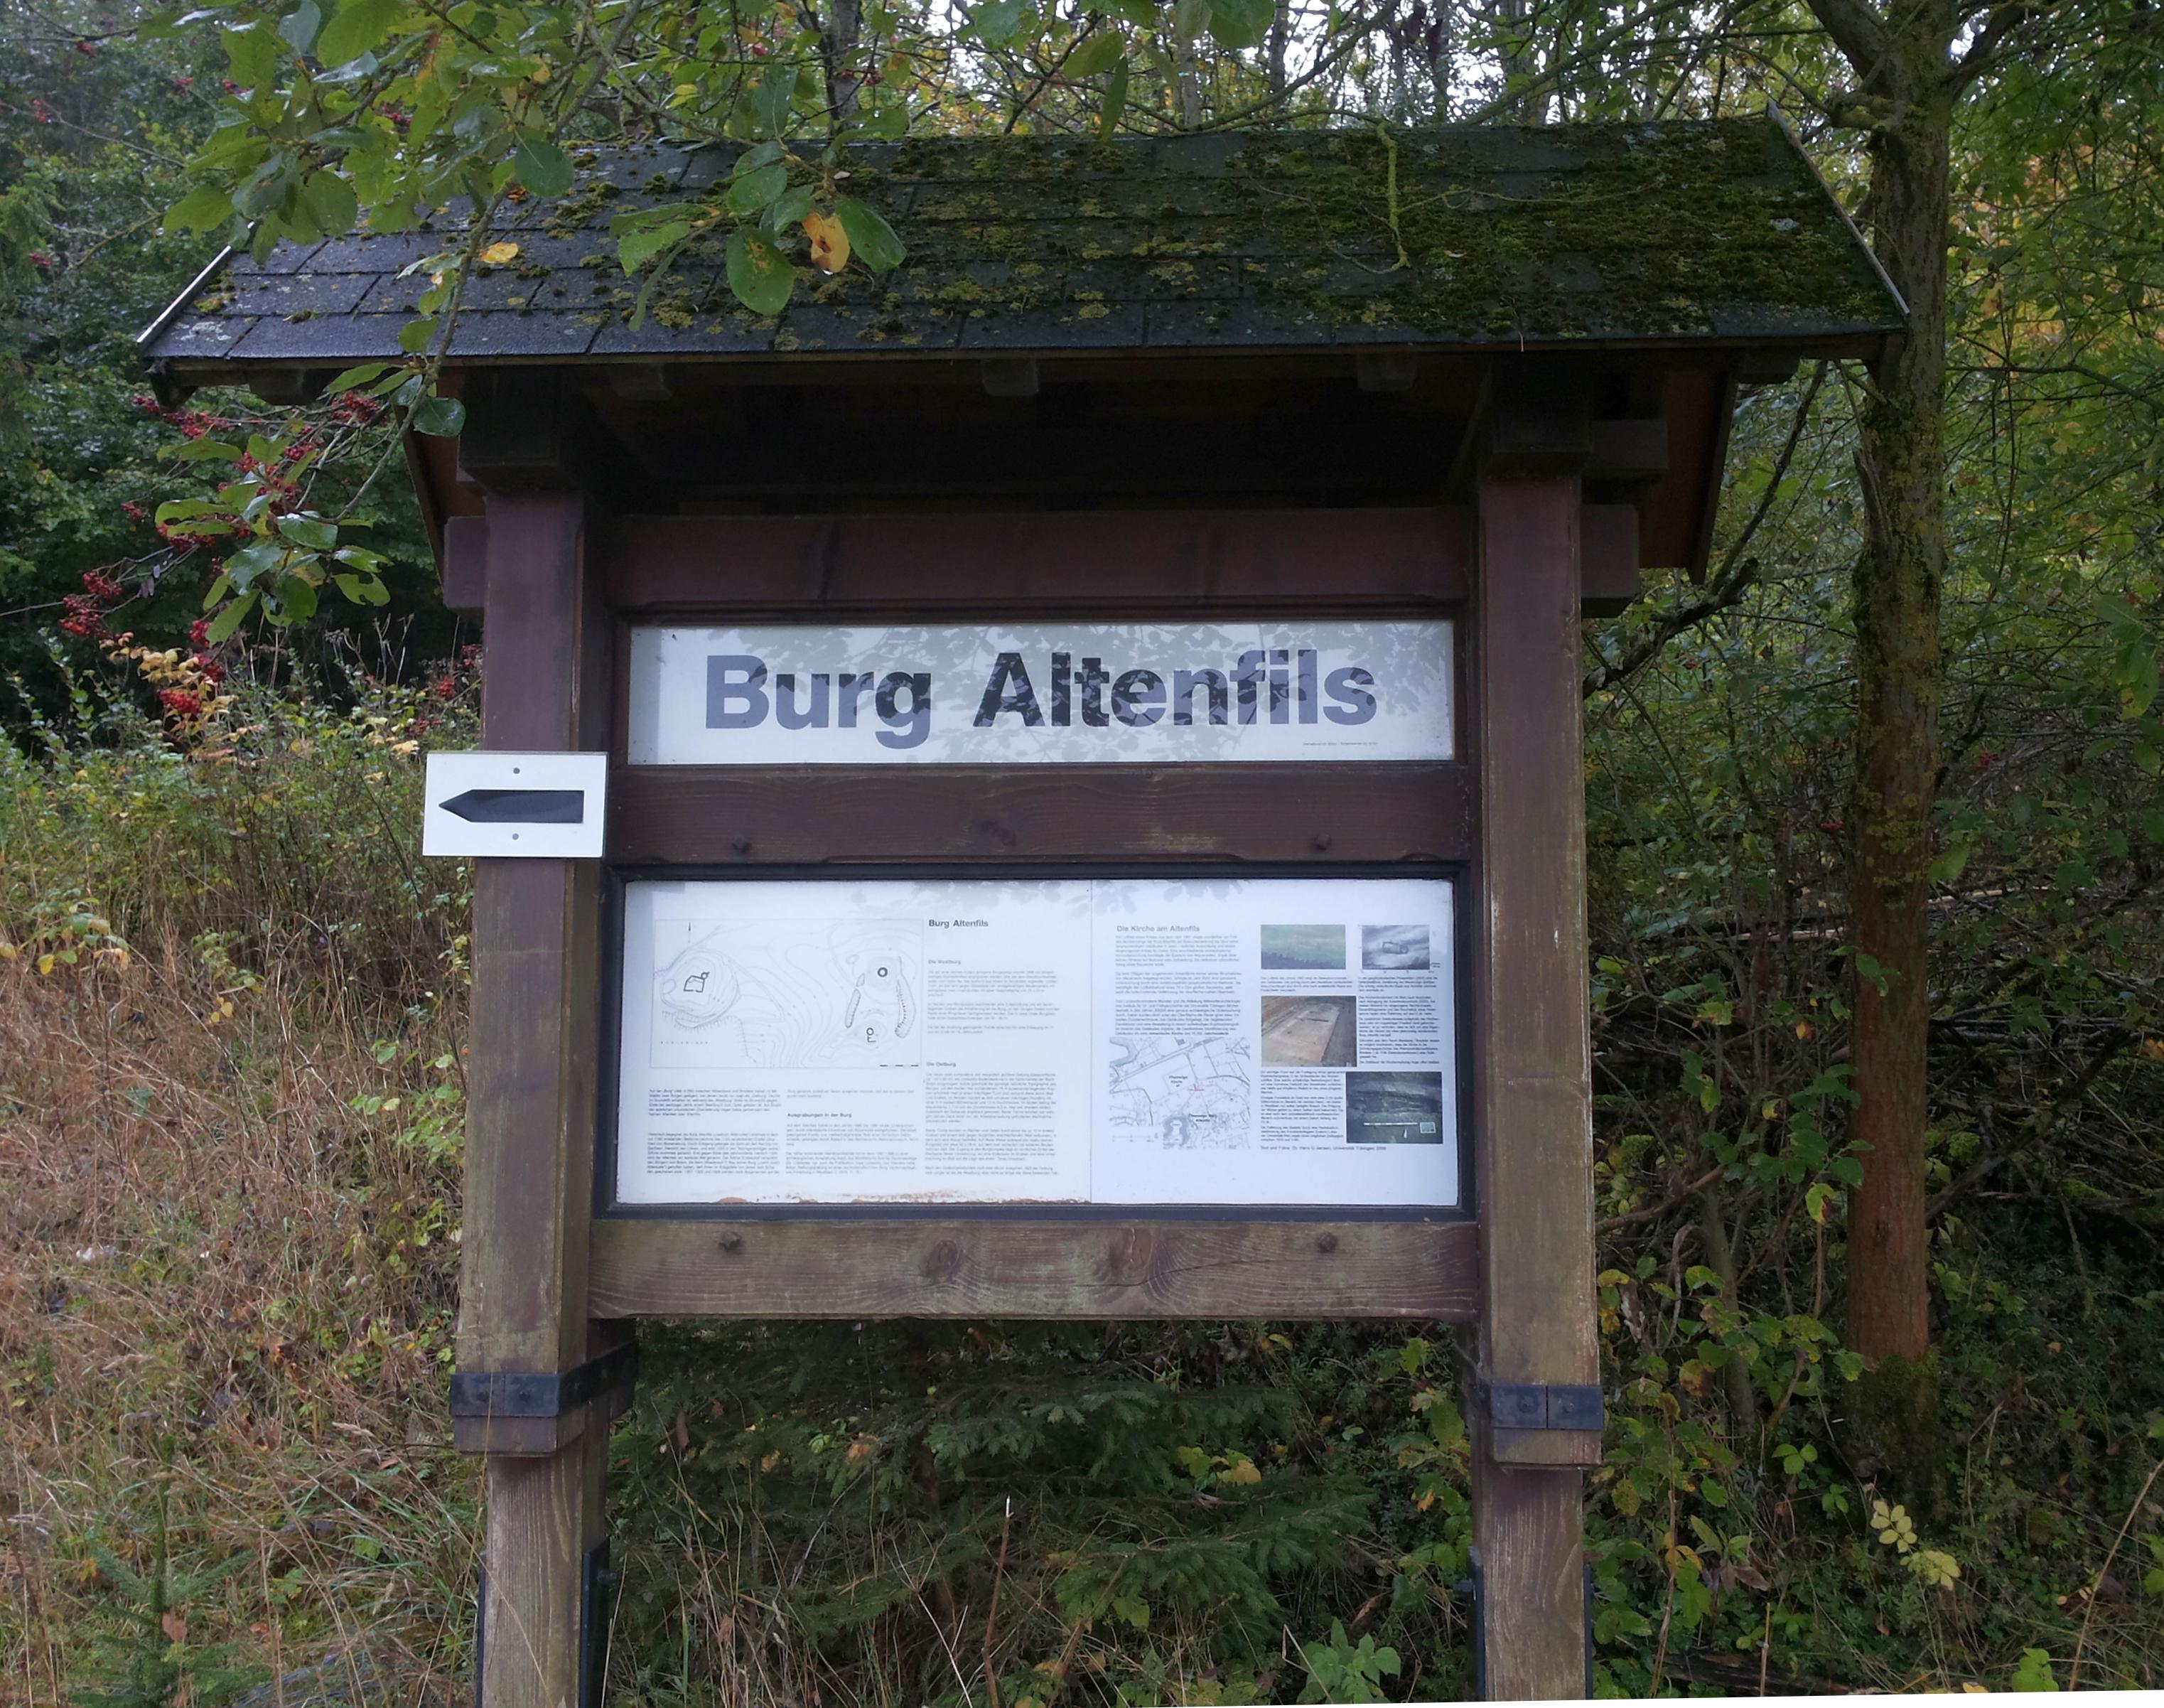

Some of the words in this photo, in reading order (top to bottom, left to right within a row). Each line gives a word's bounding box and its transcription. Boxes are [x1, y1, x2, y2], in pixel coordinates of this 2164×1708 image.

[706, 655, 932, 749] Burg
[972, 649, 1377, 728] Altenfils
[928, 919, 949, 929] Burg
[953, 919, 989, 928] Altenfils
